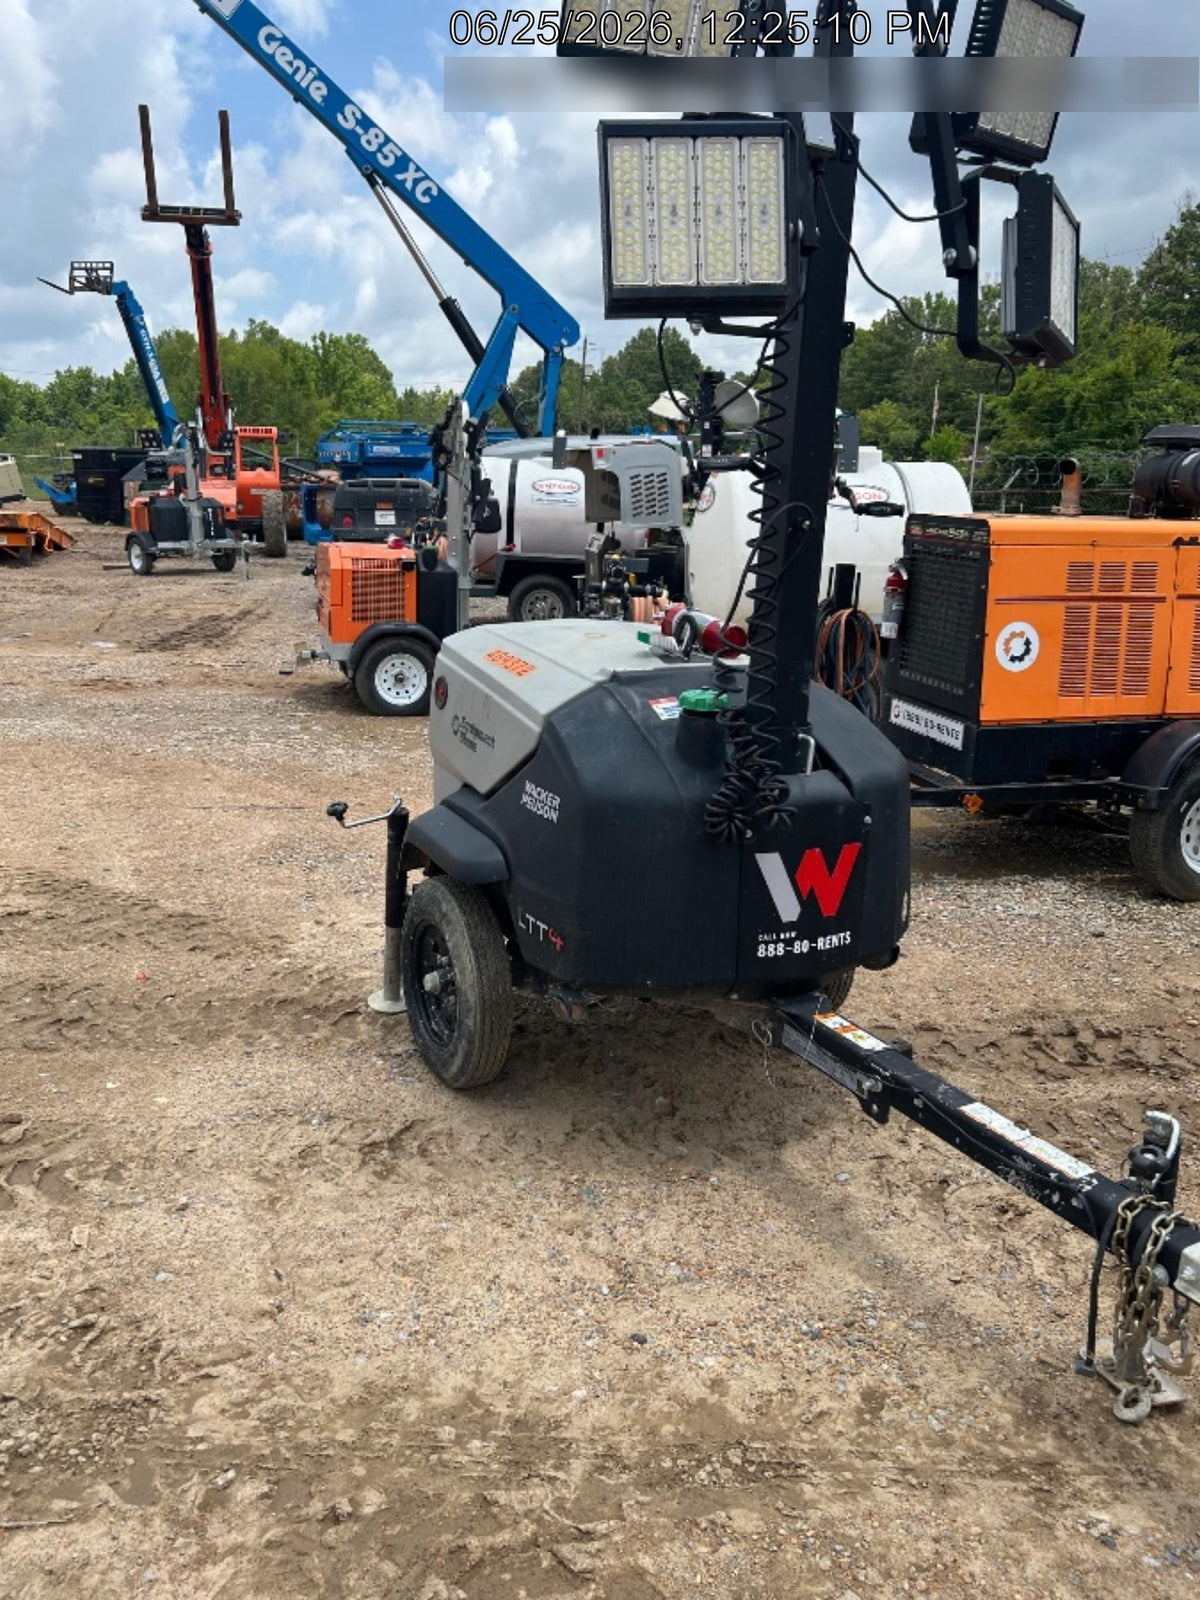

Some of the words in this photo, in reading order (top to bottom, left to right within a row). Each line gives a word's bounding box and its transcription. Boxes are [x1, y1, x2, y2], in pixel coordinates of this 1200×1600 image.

[257, 24, 328, 104] Genie
[337, 103, 402, 168] S-85
[395, 162, 438, 203] XC
[757, 930, 851, 958] 888-80-RENTS
